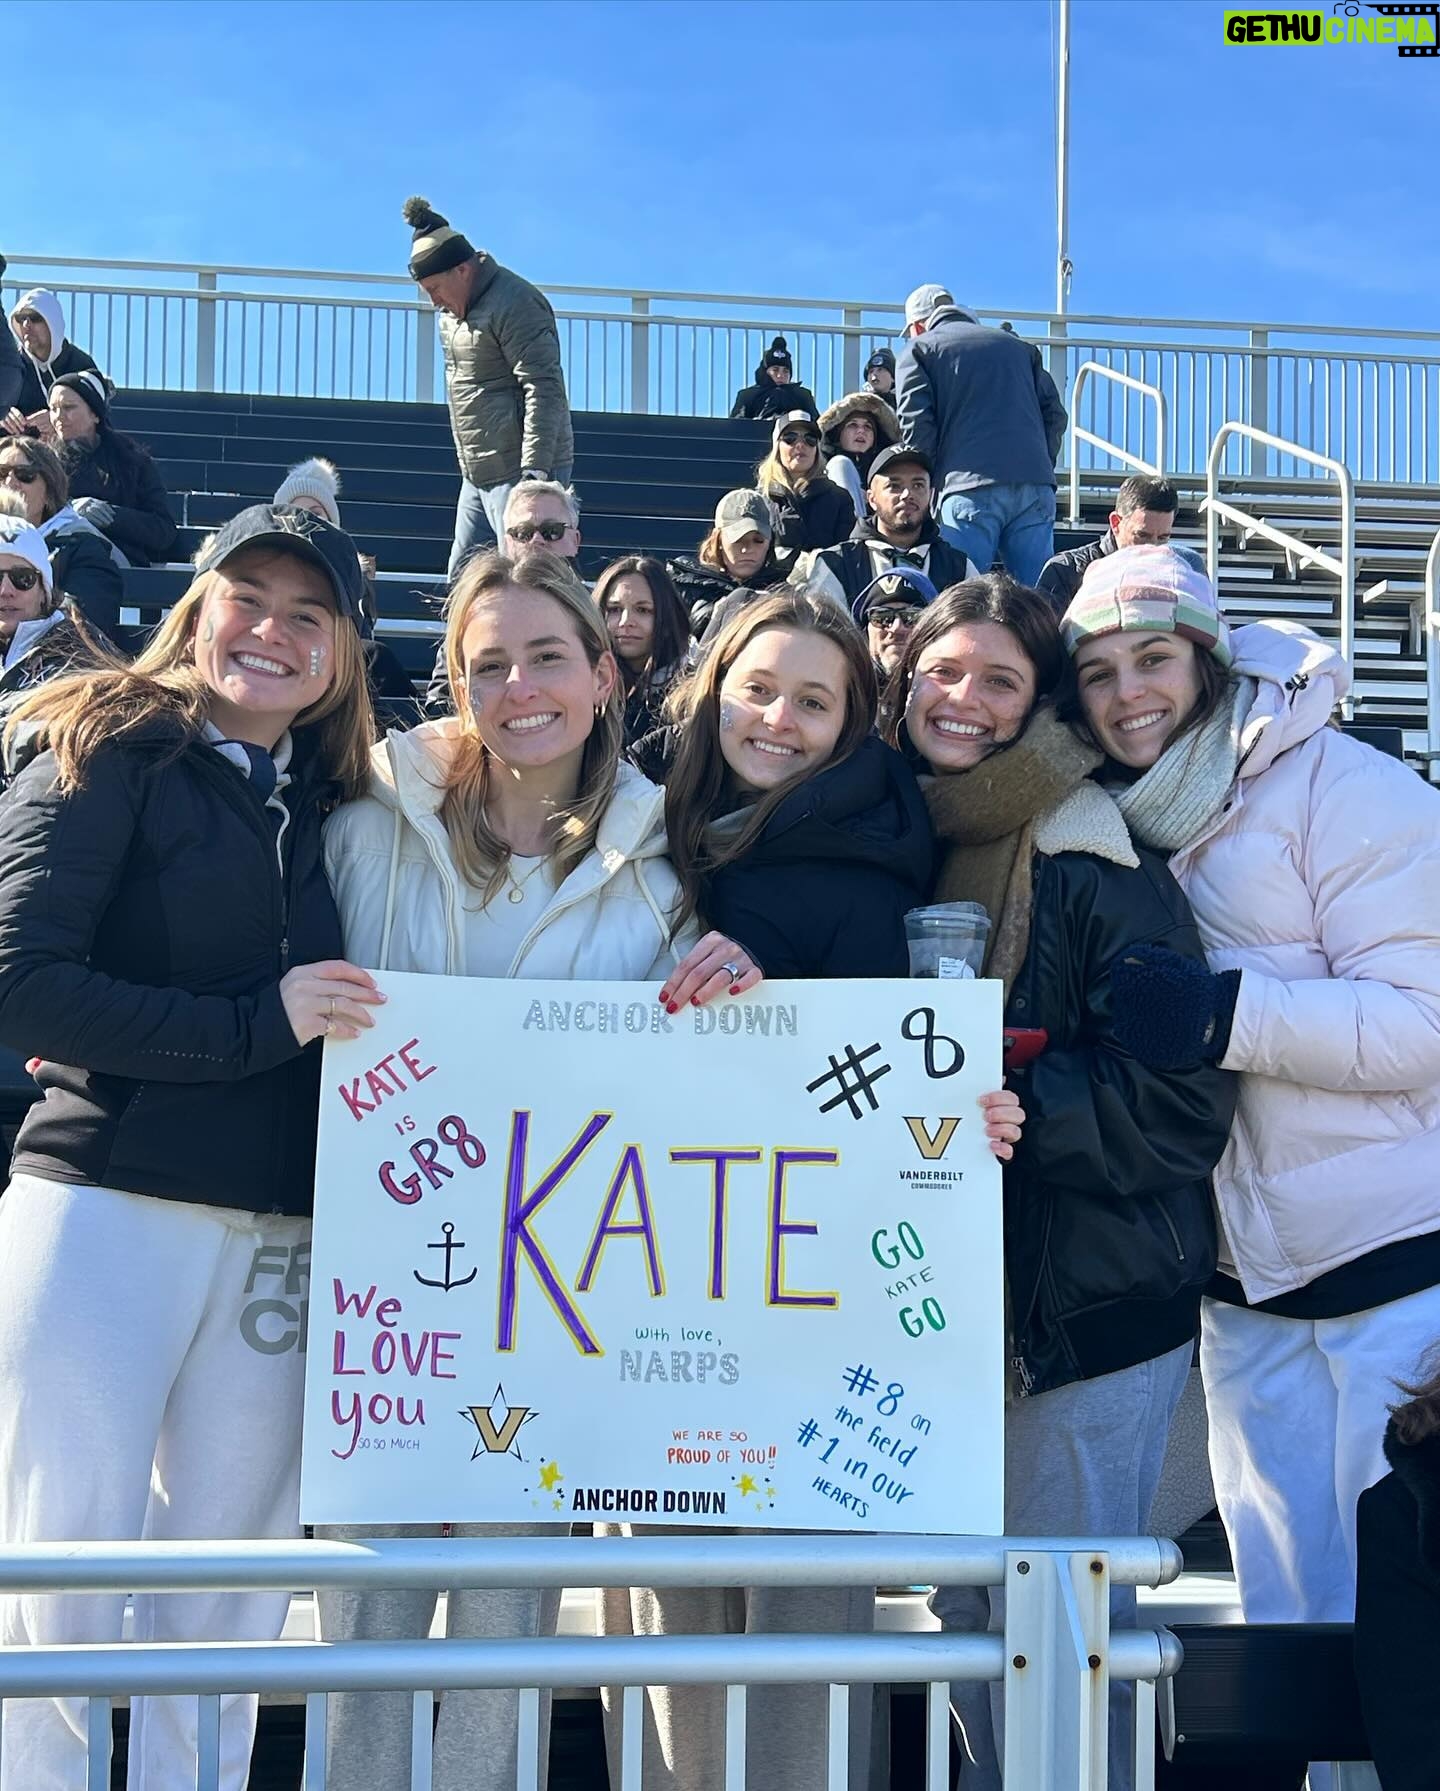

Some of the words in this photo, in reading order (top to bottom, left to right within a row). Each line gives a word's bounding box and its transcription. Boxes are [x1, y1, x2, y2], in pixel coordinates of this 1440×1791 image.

[523, 1000, 674, 1035] ANCHOR
[694, 1003, 798, 1036] DOWN
[338, 1038, 437, 1121] KATE
[378, 1115, 487, 1205] GR8
[899, 1170, 964, 1181] VANDERBILT
[495, 1109, 840, 1357] KATE
[871, 1221, 925, 1269] GO
[333, 1278, 402, 1327] We
[885, 1266, 934, 1299] KATE
[899, 1297, 946, 1337] GO
[333, 1331, 461, 1379] LOVE
[620, 1350, 739, 1385] NARPS
[842, 1364, 904, 1416] #8
[331, 1390, 425, 1459] you
[391, 1437, 420, 1450] MUCH
[672, 1430, 689, 1441] WE
[697, 1430, 723, 1441] ARE
[729, 1431, 748, 1442] SO
[834, 1405, 863, 1432] the
[867, 1426, 918, 1467] field
[667, 1448, 711, 1464] PROUD
[717, 1450, 731, 1463] OF
[797, 1418, 840, 1464] #1
[843, 1458, 868, 1479] in
[573, 1489, 657, 1512] ANCHOR
[663, 1490, 727, 1514] DOWN
[812, 1476, 869, 1518] HEARTS
